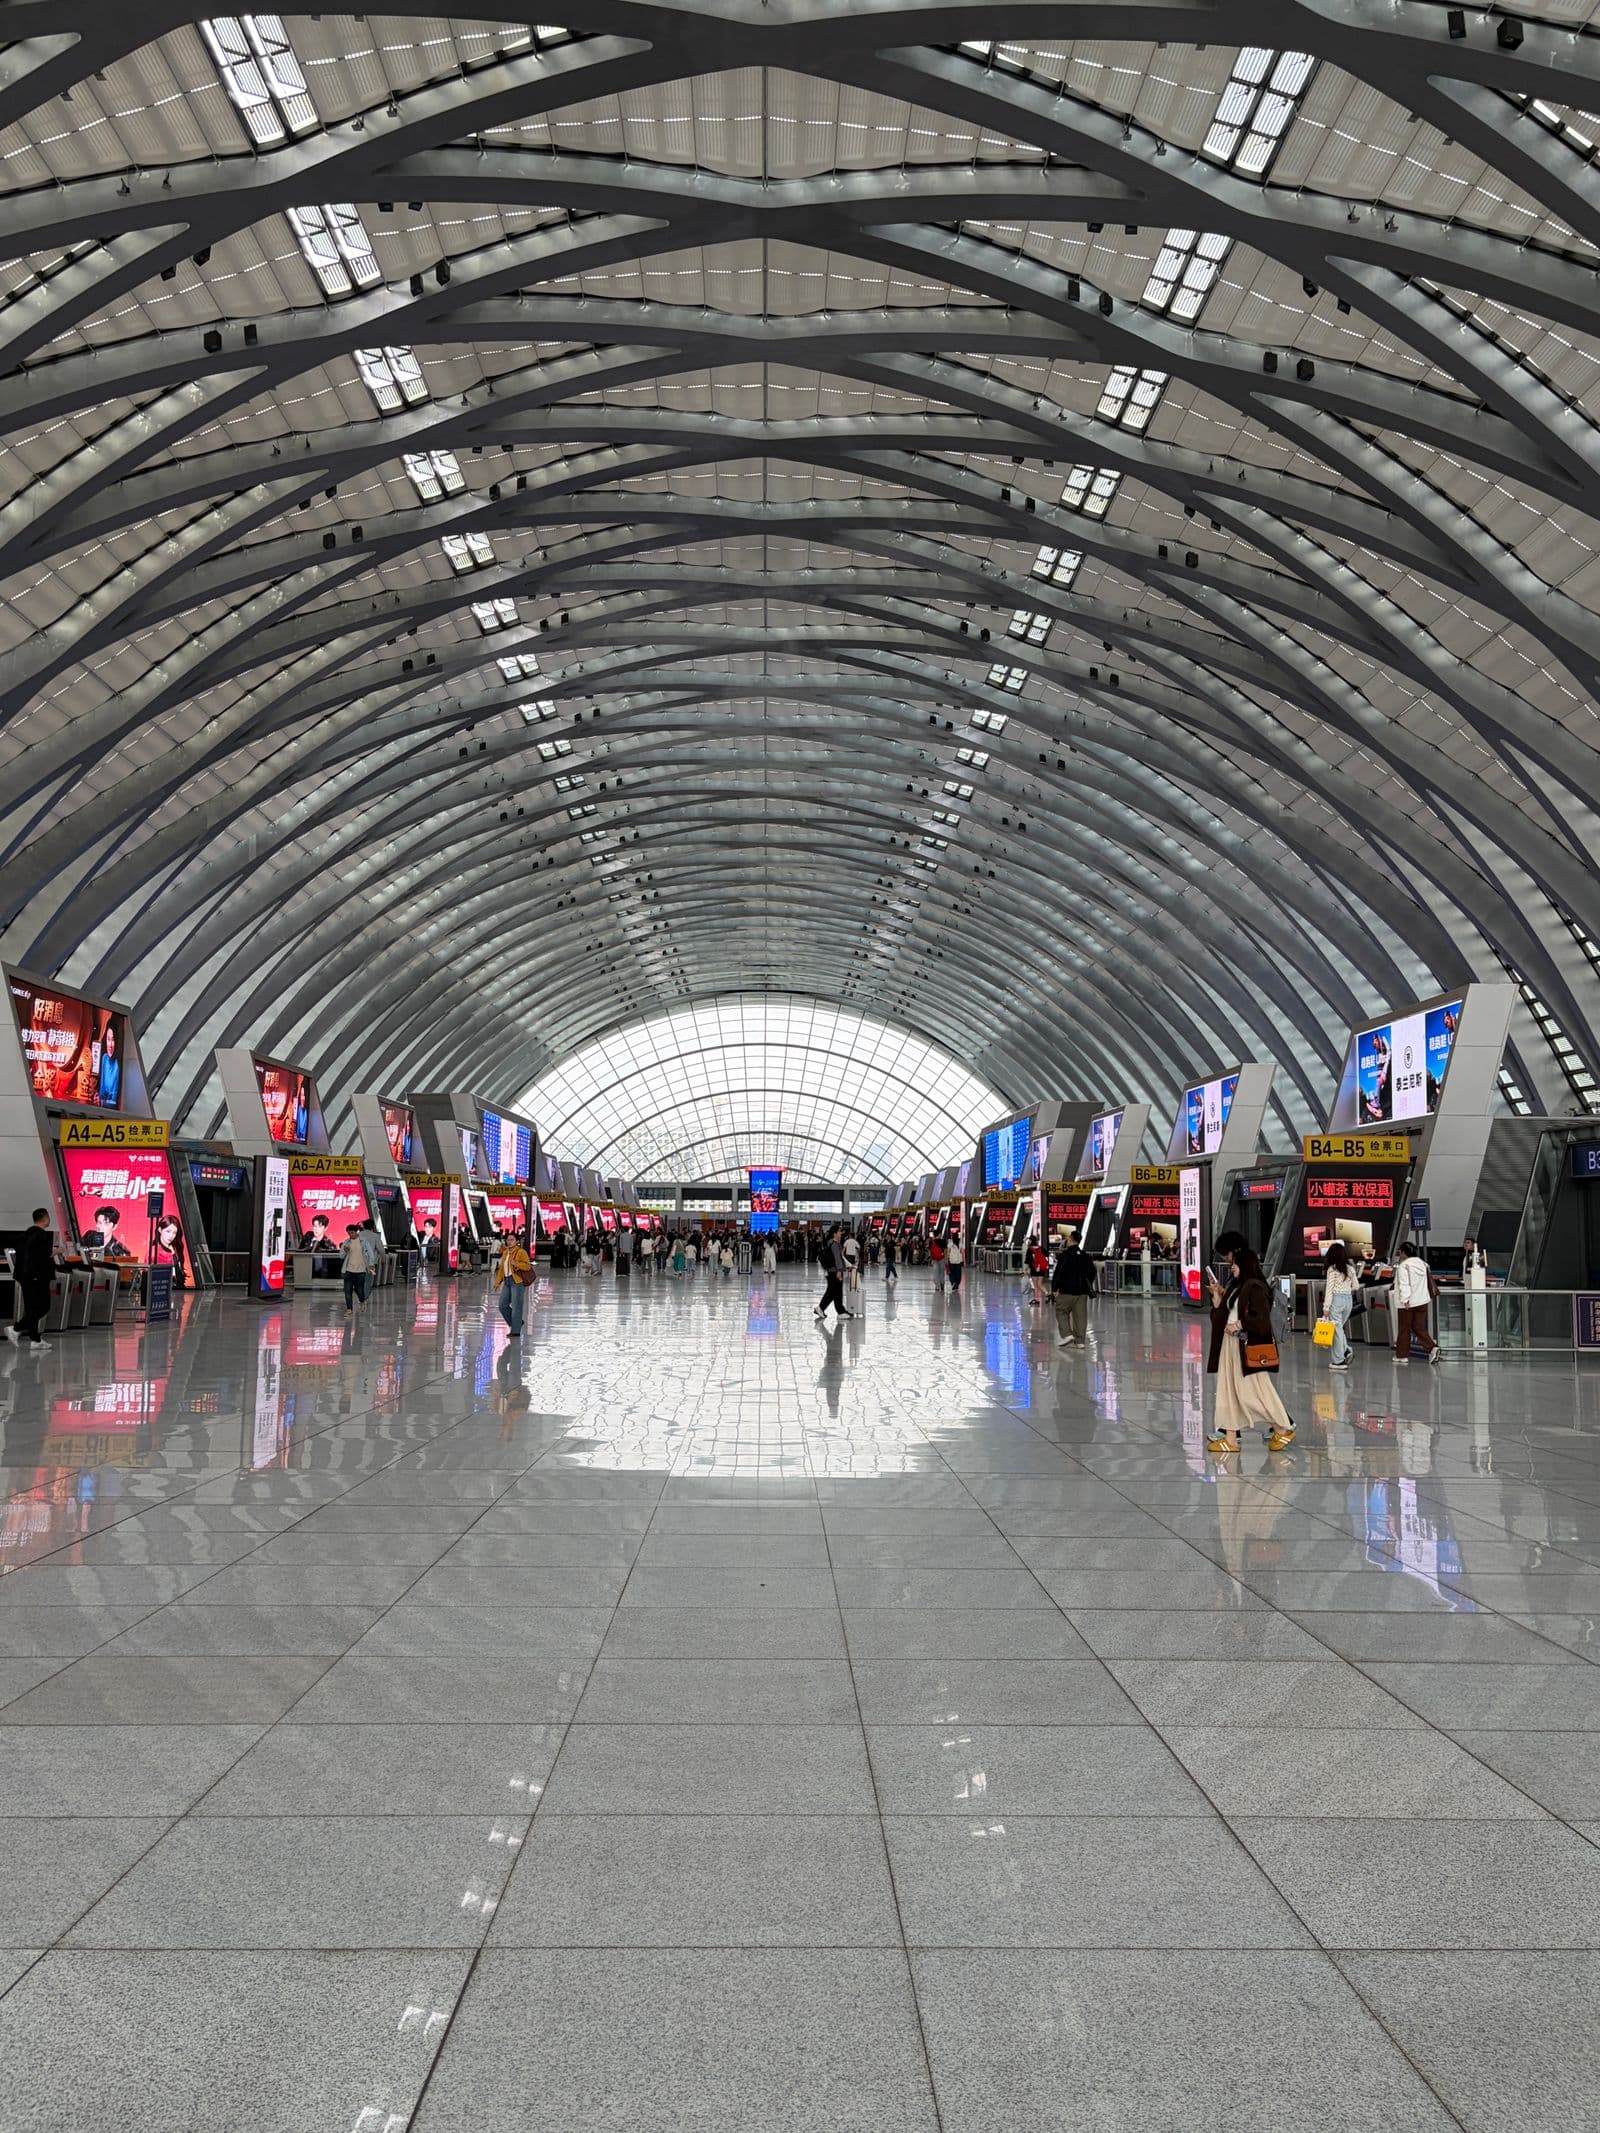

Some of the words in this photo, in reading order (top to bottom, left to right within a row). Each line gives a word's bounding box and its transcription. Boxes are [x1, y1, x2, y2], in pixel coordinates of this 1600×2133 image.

[34, 999, 64, 1024] 好消息
[67, 1124, 125, 1142] A4-A5
[128, 1125, 163, 1136] 检票口
[1311, 1140, 1364, 1157] B4-B5
[1370, 1141, 1403, 1151] 检票口
[292, 1159, 332, 1171] A6-A7
[81, 1169, 129, 1184] 高端智能
[408, 1176, 439, 1186] A8-A9
[1135, 1169, 1172, 1181] B6-B7
[1045, 1183, 1074, 1193] B8-B9
[1311, 1182, 1348, 1197] 小罐茶
[1352, 1182, 1391, 1197] 敢保真
